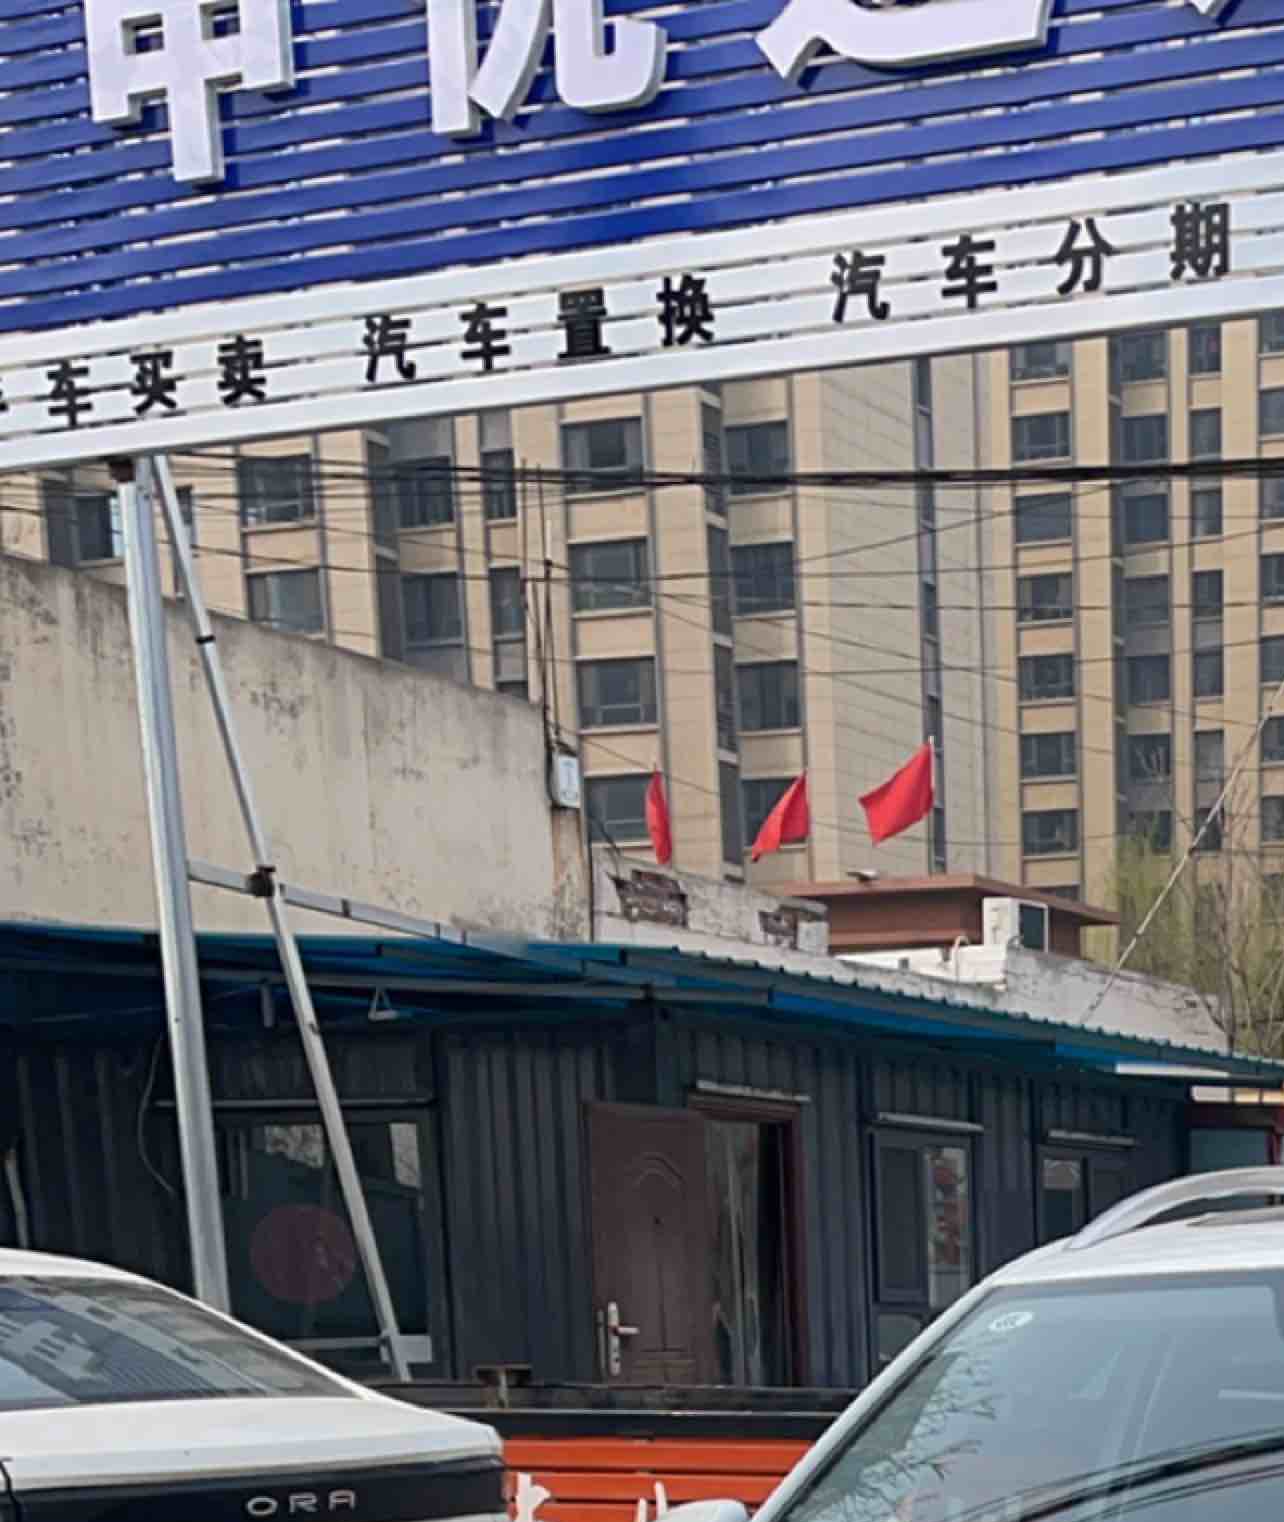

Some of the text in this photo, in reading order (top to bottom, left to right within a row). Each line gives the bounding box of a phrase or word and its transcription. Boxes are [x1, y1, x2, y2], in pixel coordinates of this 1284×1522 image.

[0, 335, 268, 428] 车买卖
[362, 273, 716, 383] 汽车置换
[831, 201, 1230, 323] 汽车分期
[246, 1488, 357, 1517] ORA
